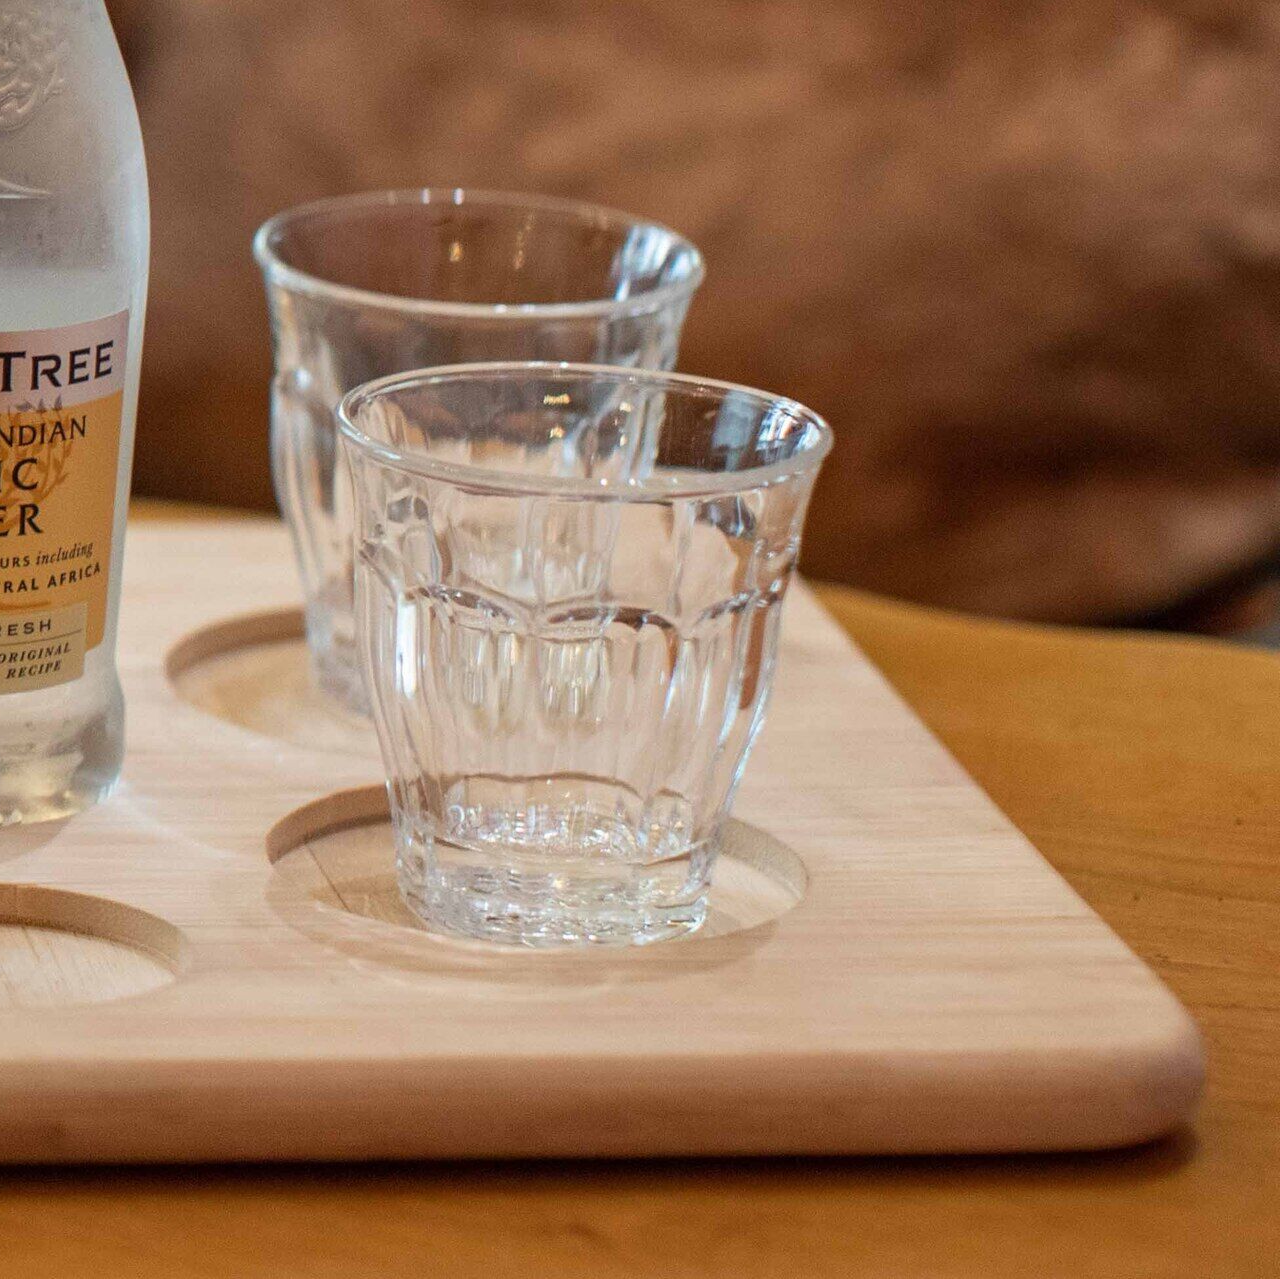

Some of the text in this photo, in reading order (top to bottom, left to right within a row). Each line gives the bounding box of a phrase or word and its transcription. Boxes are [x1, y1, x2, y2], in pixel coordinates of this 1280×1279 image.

[35, 542, 93, 566] including
[47, 563, 101, 589] AFRICA
[6, 659, 61, 680] RECIPE
